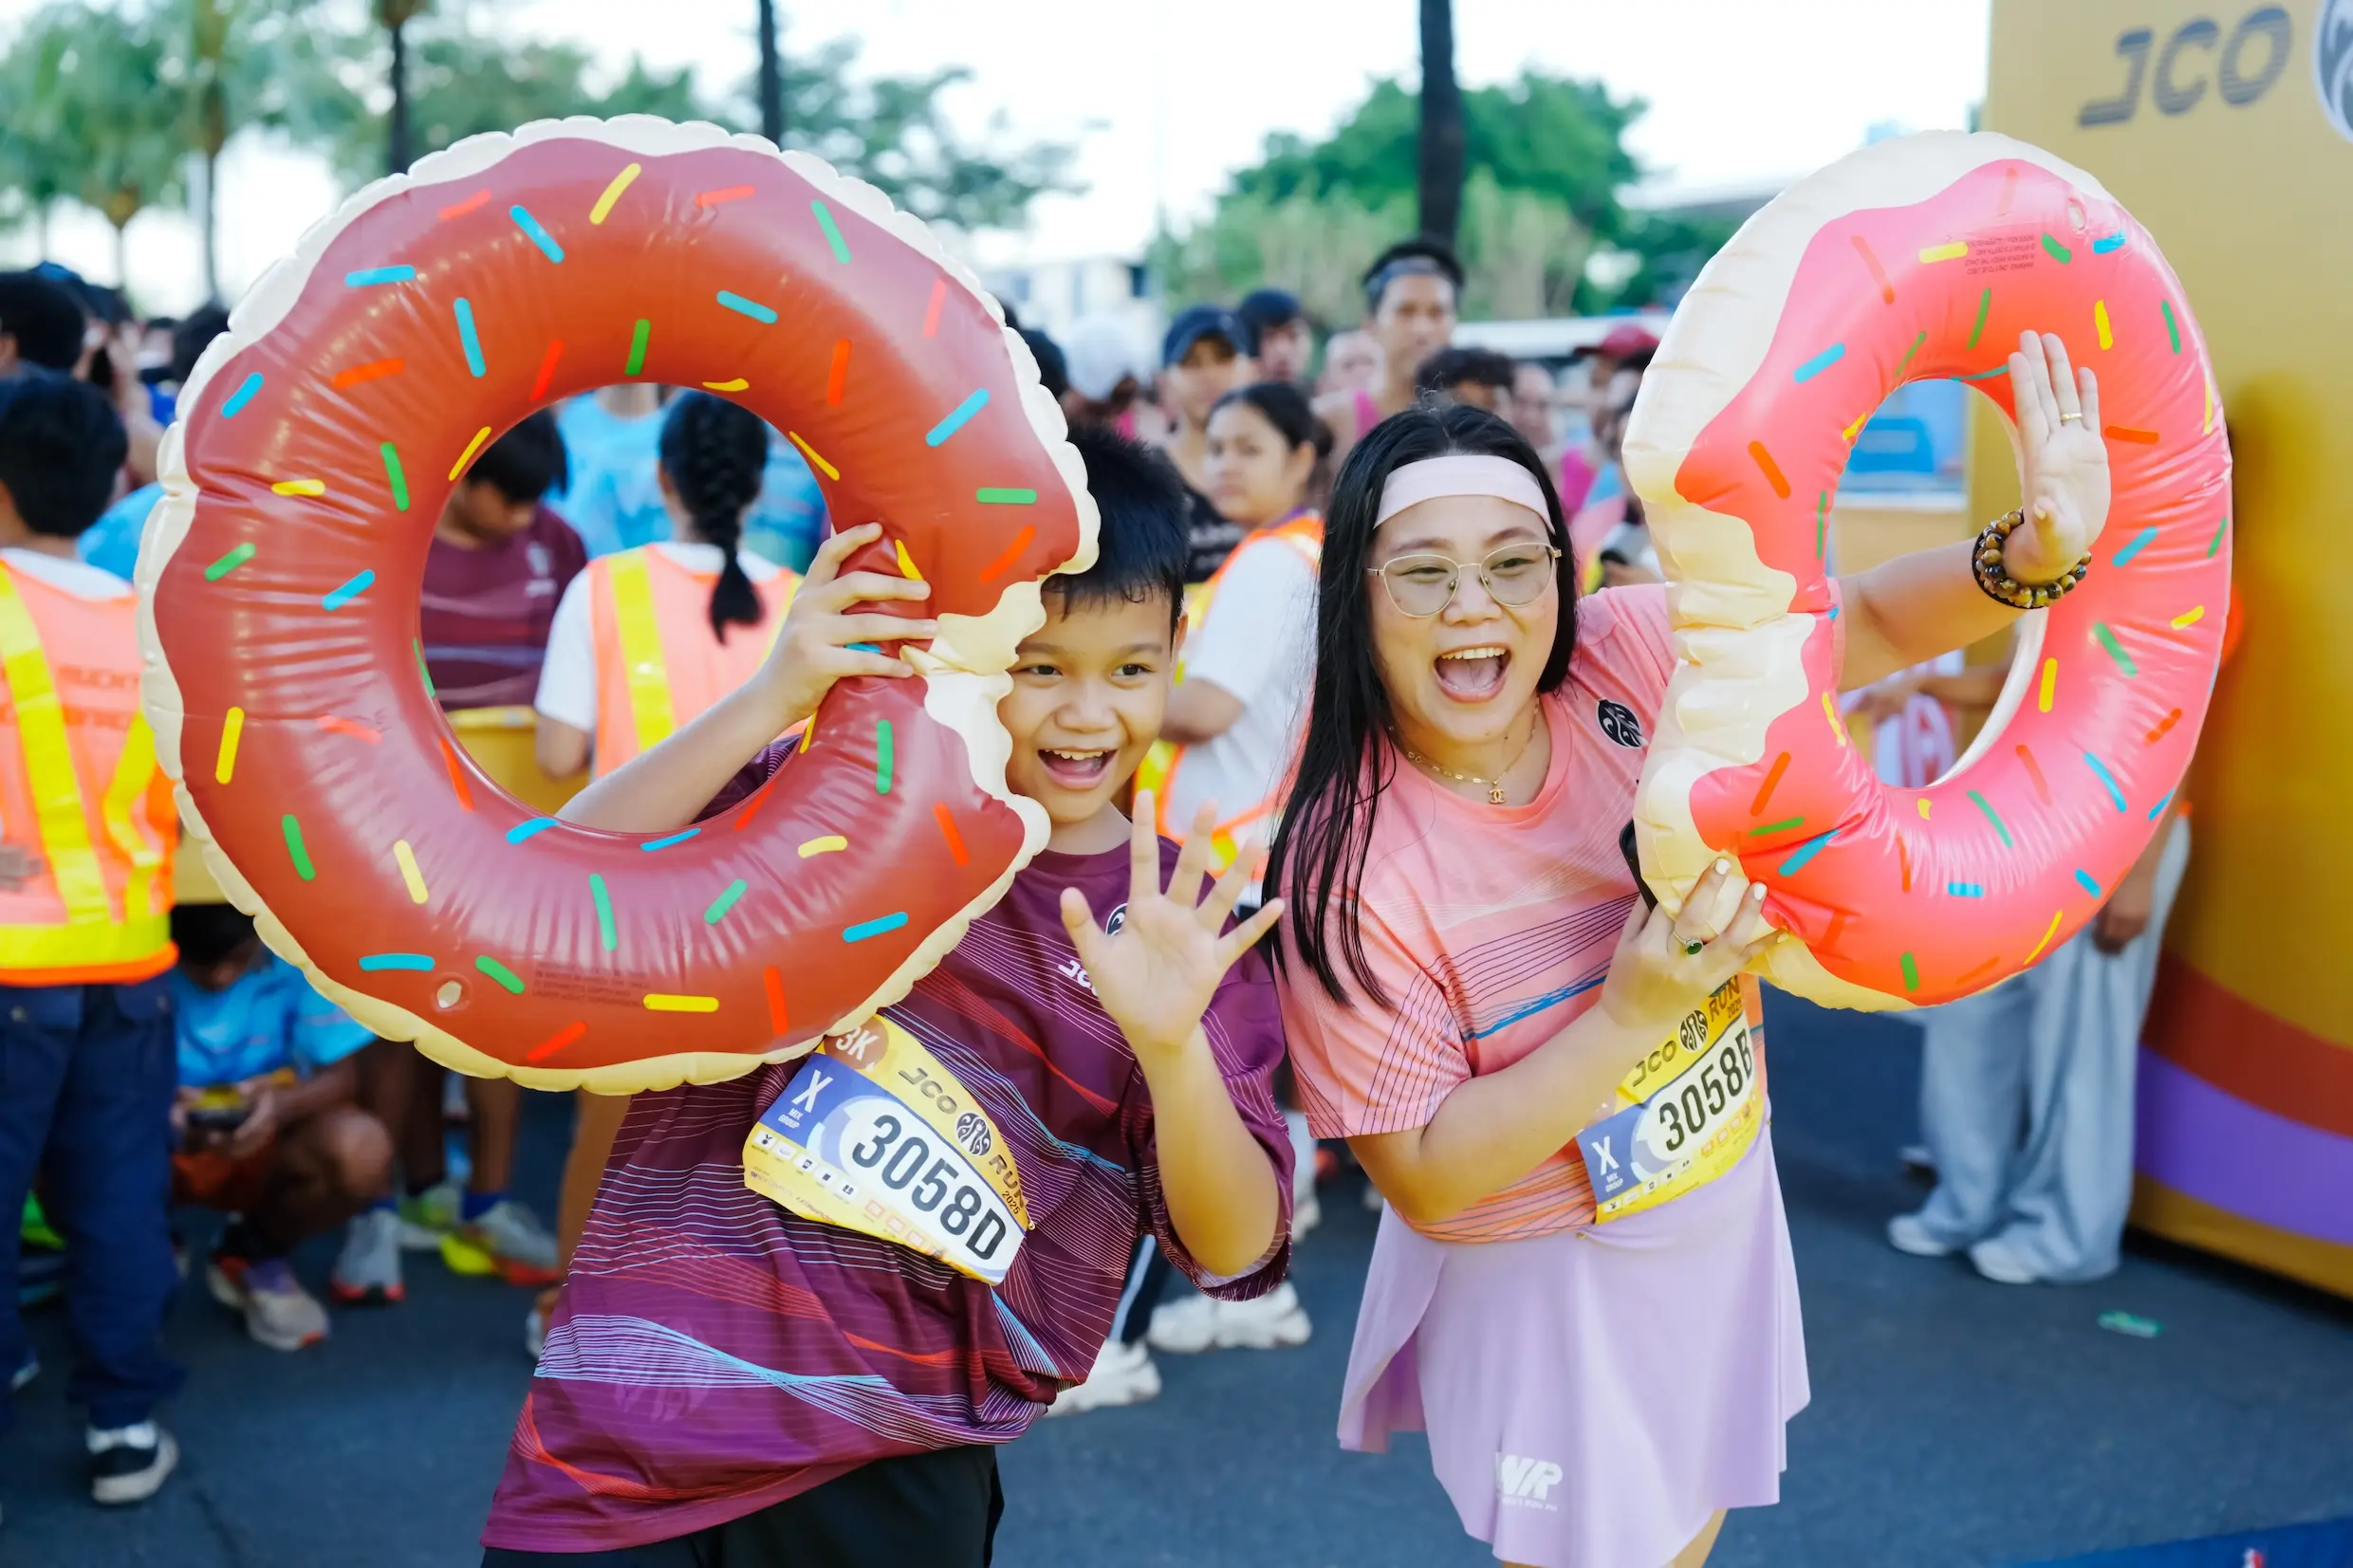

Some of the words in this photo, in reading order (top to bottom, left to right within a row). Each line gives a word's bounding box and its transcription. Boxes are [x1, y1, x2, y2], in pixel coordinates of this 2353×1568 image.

[2078, 5, 2291, 127] JCO
[1058, 959, 1099, 997] JC
[836, 1026, 880, 1061] 3K
[1632, 1040, 1677, 1087] JCO
[1709, 975, 1740, 1023] RUN
[791, 1069, 833, 1114] X
[899, 1067, 958, 1115] JCO
[778, 1114, 800, 1129] GROUP
[787, 1108, 804, 1120] MIX
[1591, 1135, 1620, 1176] X
[851, 1114, 1007, 1261] 3058D
[1002, 1190, 1020, 1214] 2025
